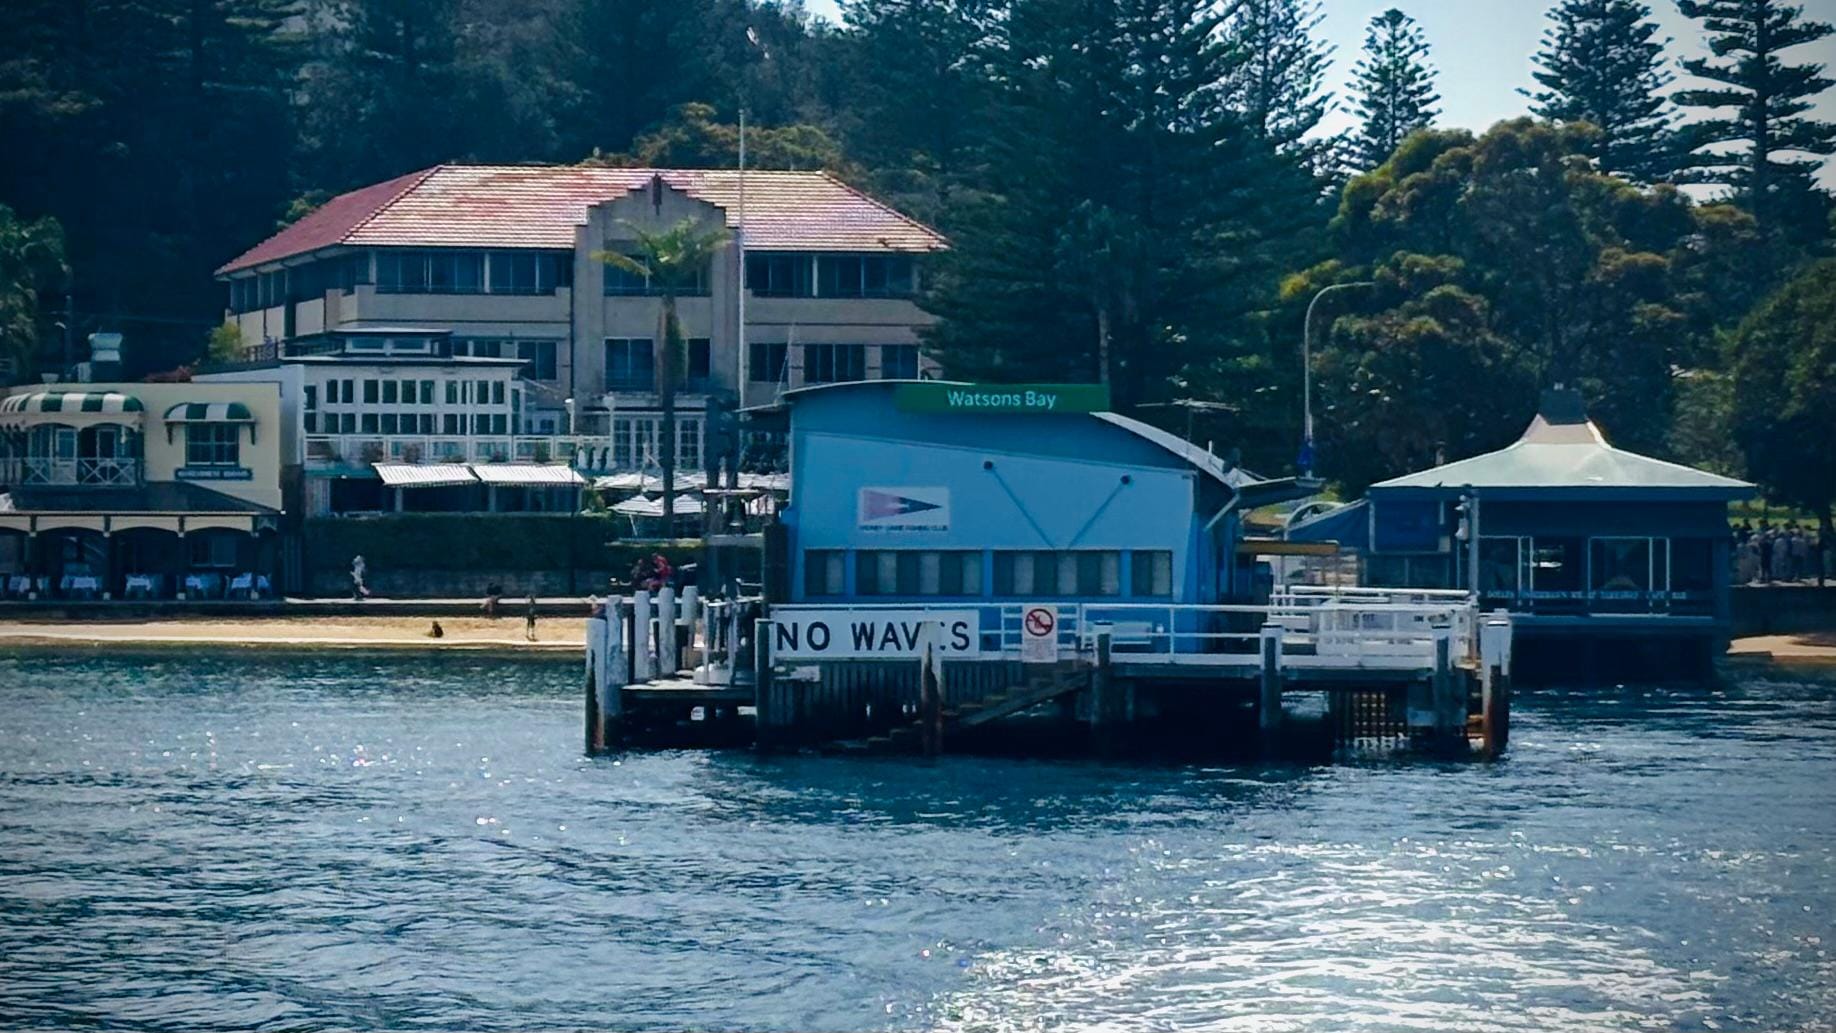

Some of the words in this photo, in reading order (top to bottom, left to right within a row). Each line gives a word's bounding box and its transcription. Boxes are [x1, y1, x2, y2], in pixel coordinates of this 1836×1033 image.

[947, 390, 1021, 406] Watsons
[1025, 390, 1056, 410] Bay
[776, 621, 831, 651] NO
[851, 621, 970, 651] WAVS
